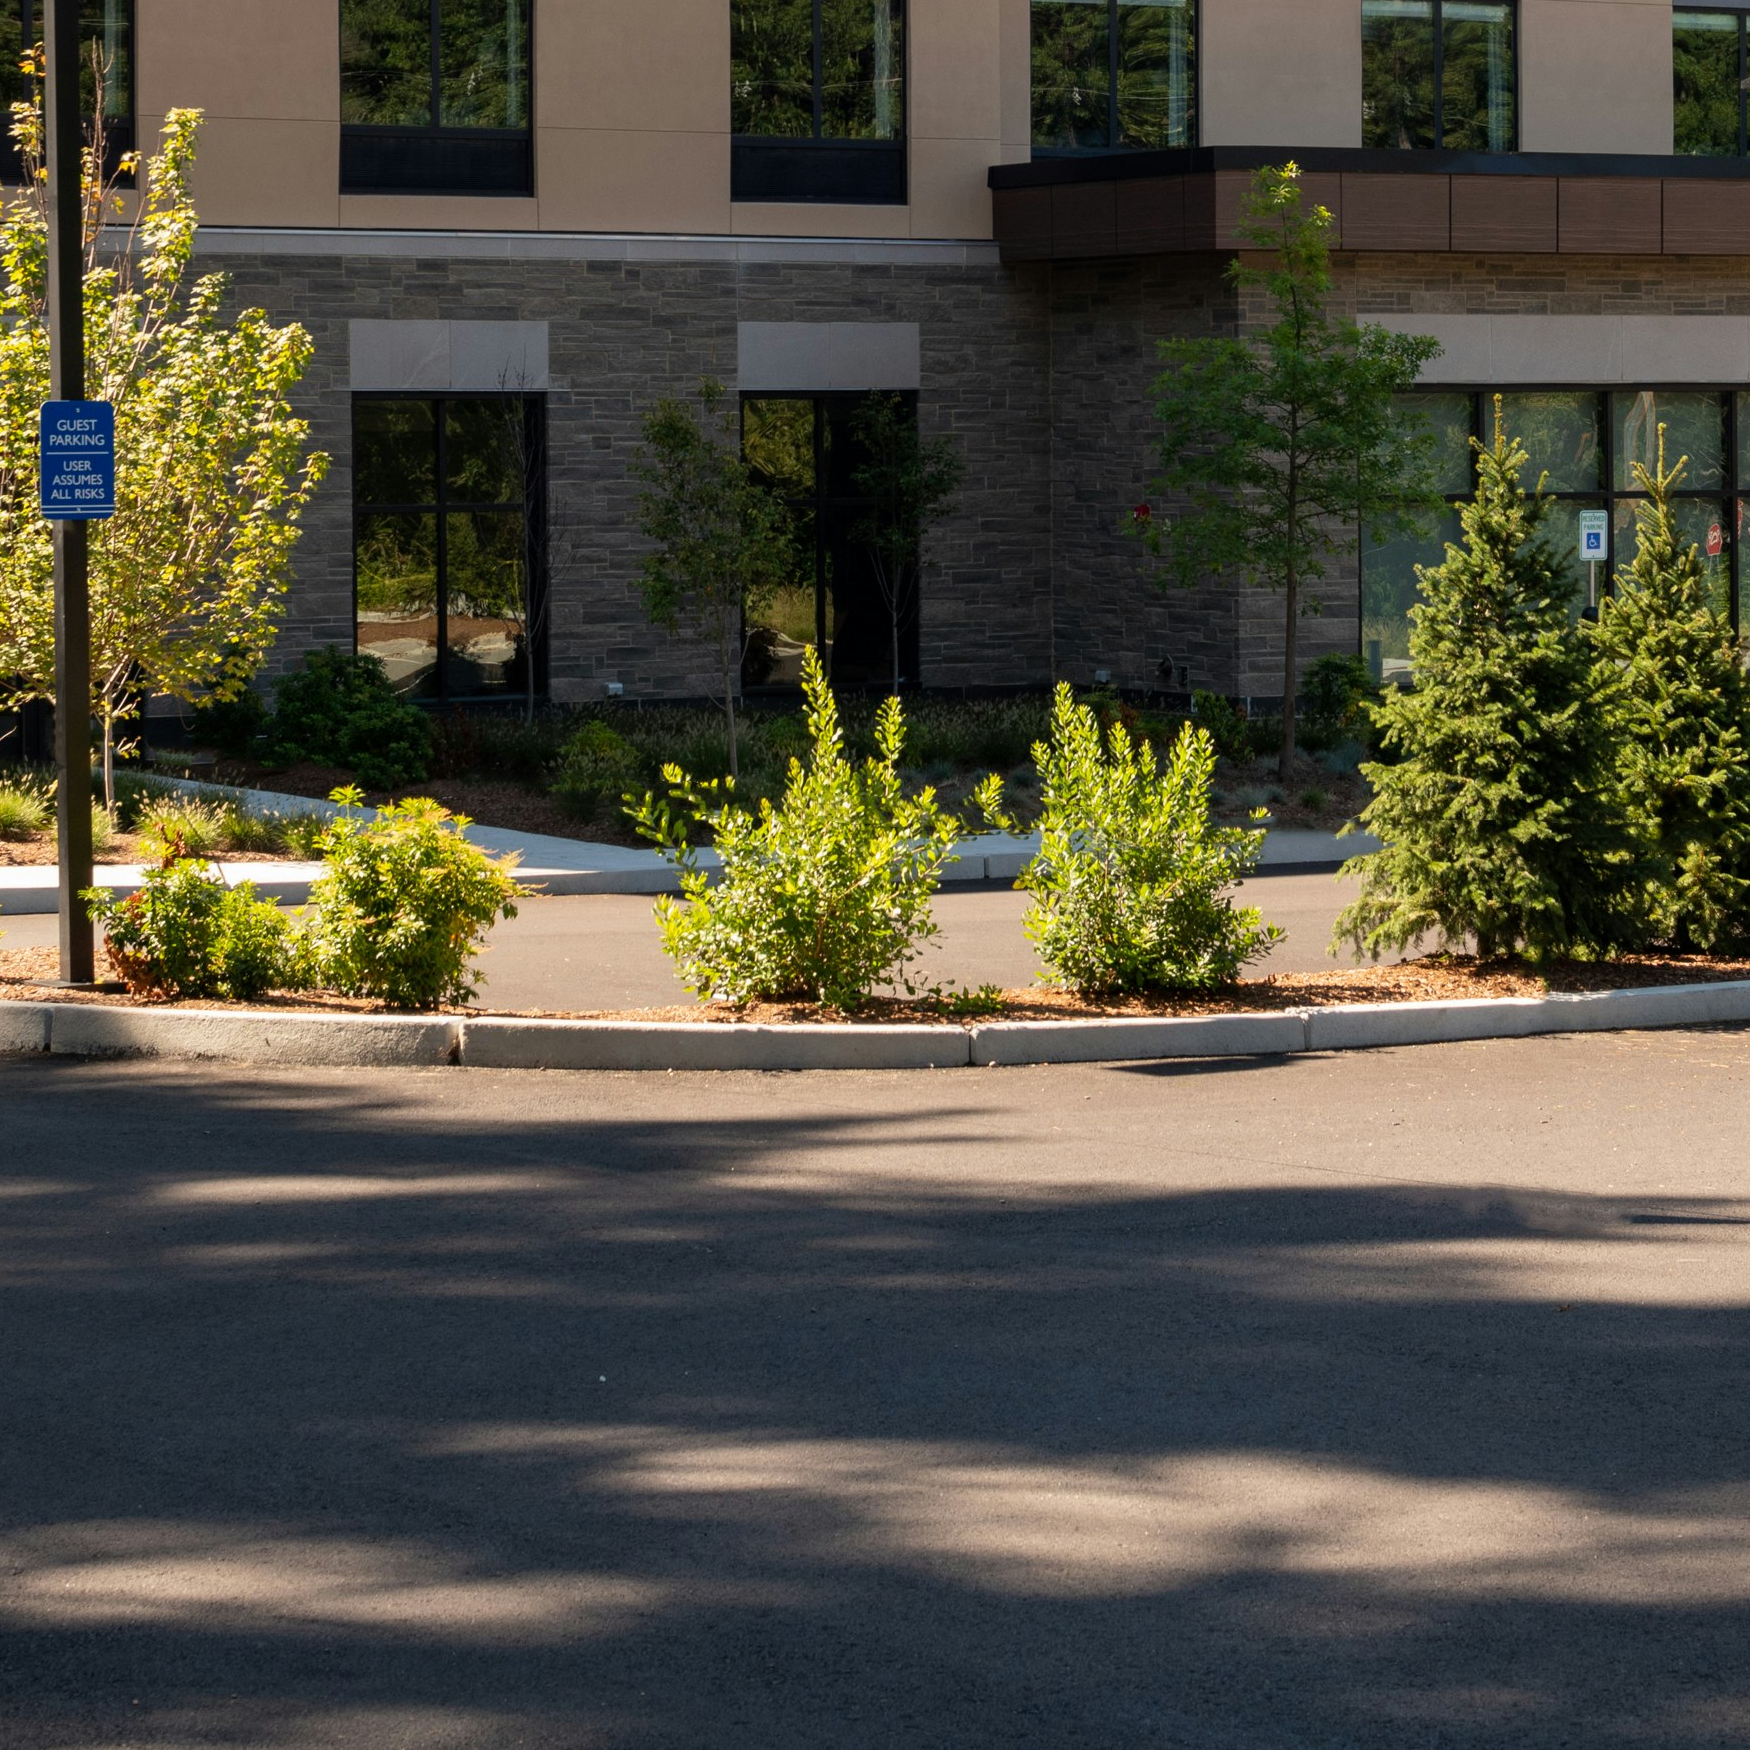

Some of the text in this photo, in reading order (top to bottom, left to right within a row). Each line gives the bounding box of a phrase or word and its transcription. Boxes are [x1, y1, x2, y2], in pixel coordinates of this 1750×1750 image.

[57, 419, 97, 431] GUEST
[49, 434, 105, 446] PARKING
[63, 460, 92, 471] USER
[52, 474, 103, 485] ASSUMES
[50, 488, 105, 499] ALL RISKS
